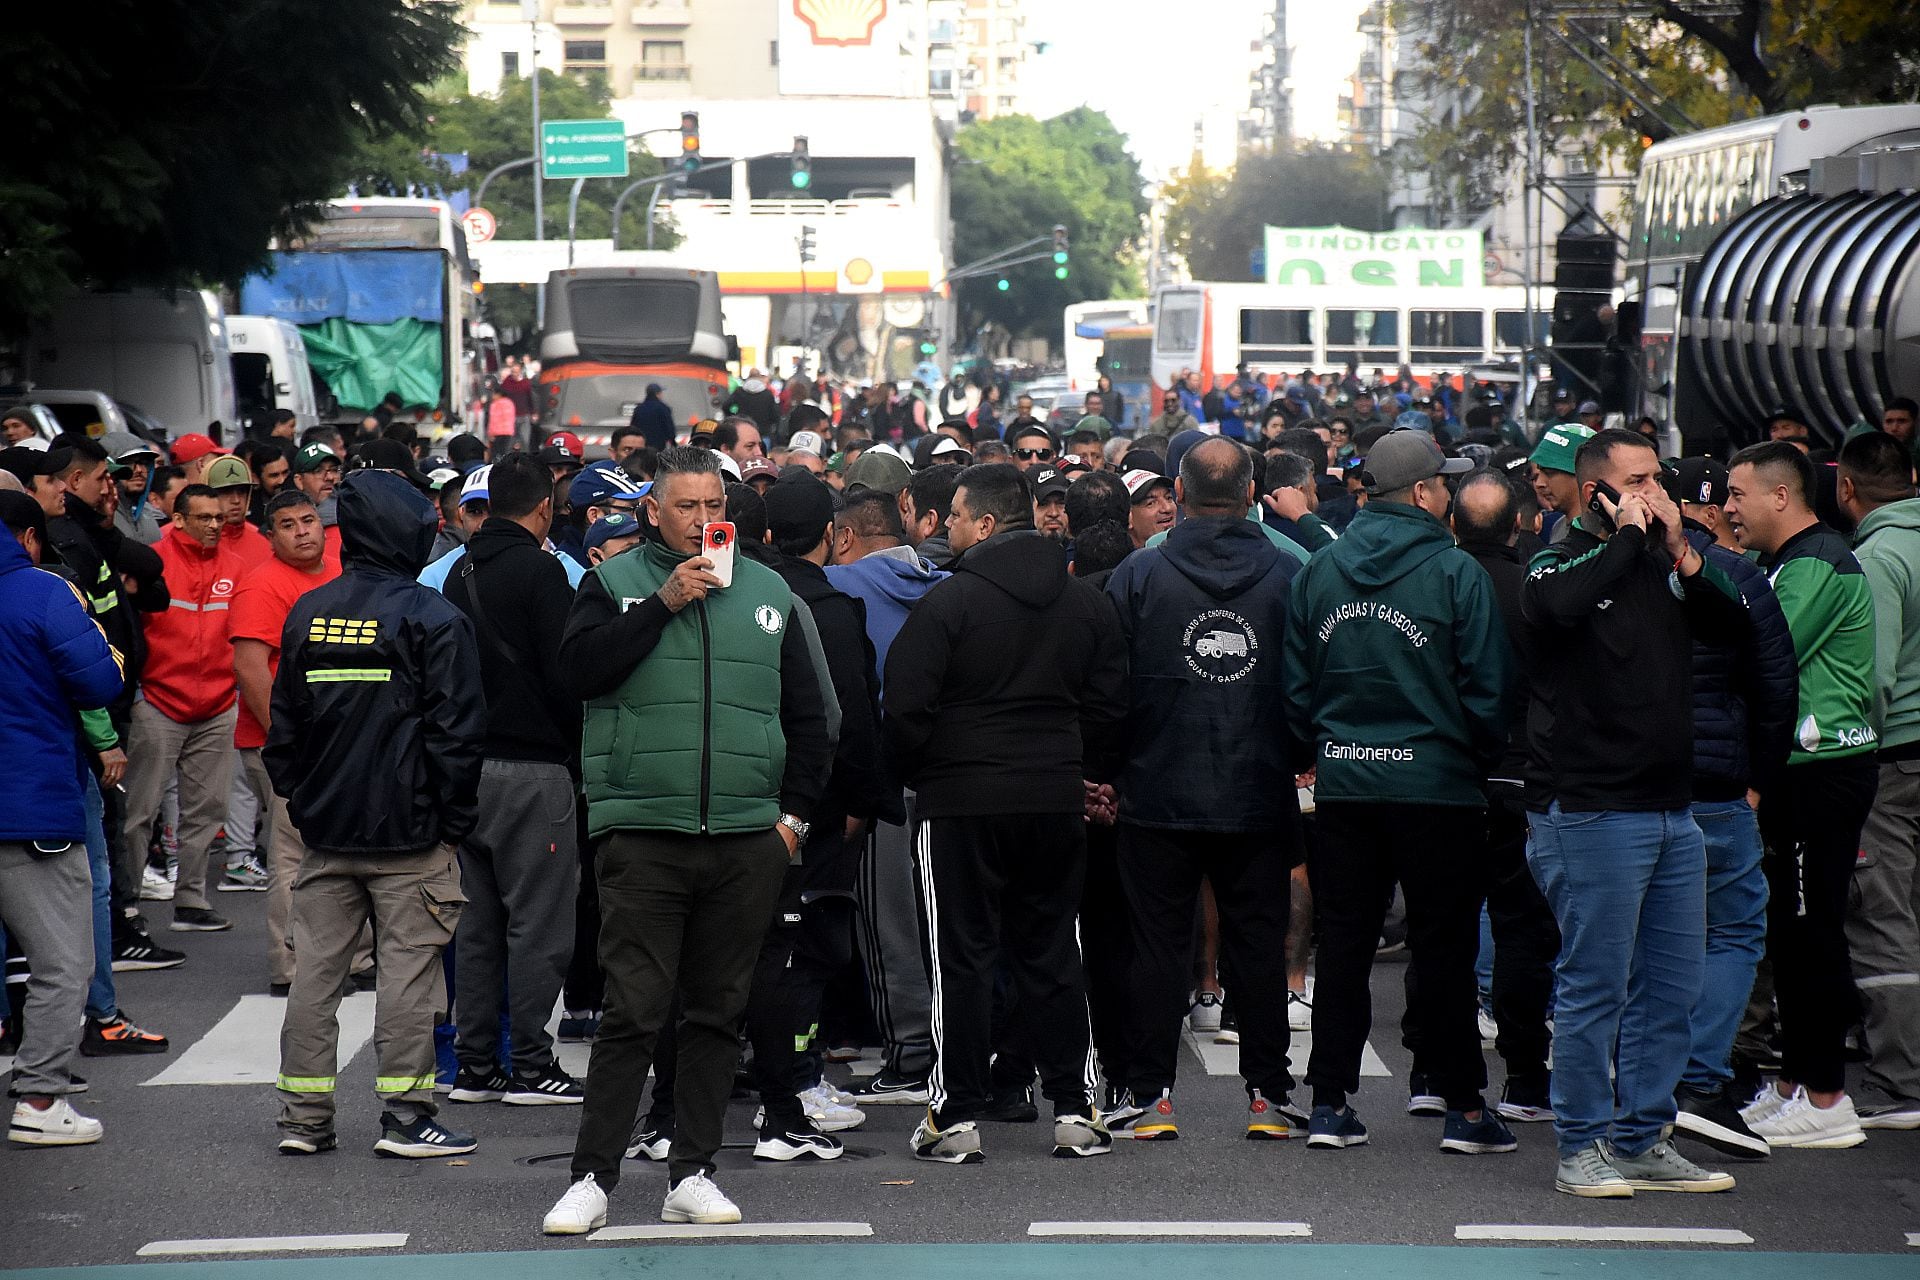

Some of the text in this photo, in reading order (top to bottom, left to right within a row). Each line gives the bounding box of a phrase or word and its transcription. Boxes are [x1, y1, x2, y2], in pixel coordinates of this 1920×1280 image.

[1285, 234, 1464, 251] SINDICATO
[1039, 469, 1056, 479] NIKE
[309, 617, 378, 645] BEES
[1183, 619, 1199, 647] SINDICATO
[1198, 612, 1208, 622] DE
[1207, 609, 1236, 620] CHOFERES
[1235, 615, 1245, 625] DE
[1318, 601, 1428, 648] RAMA AGUAS Y GASEOSAS
[1184, 655, 1257, 682] AGUAS Y GASEOSAS
[1324, 741, 1414, 761] Camioneros
